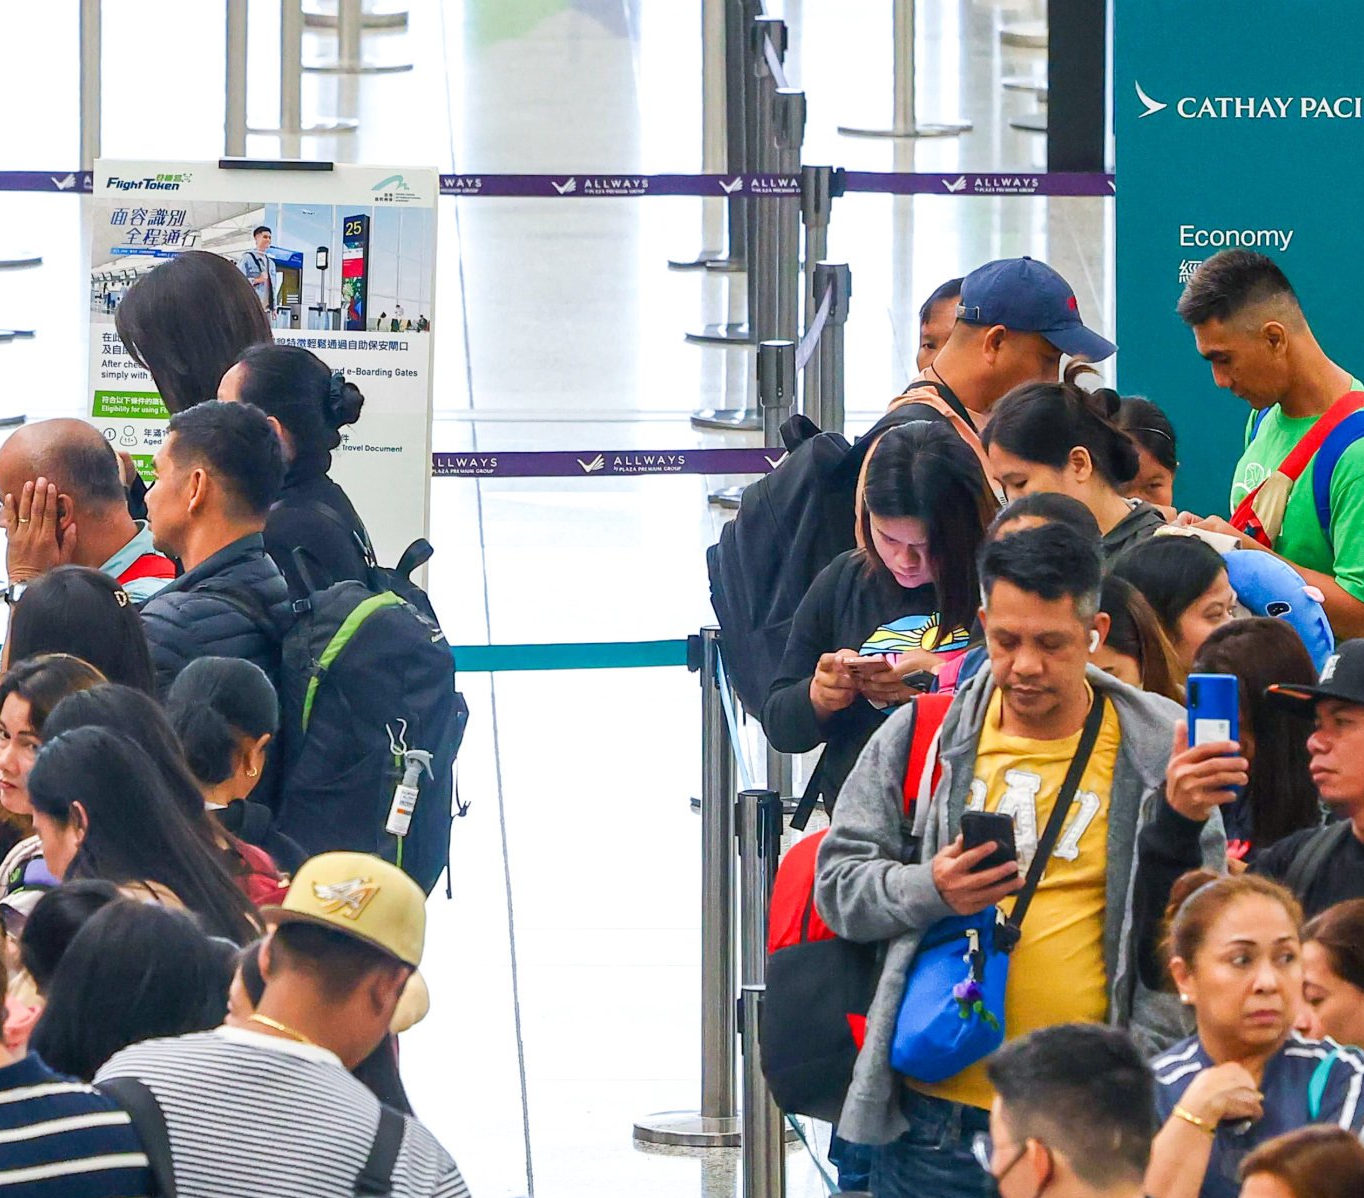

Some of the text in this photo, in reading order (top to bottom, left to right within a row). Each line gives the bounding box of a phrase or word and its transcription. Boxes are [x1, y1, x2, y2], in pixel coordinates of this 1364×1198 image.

[1177, 97, 1294, 119] CATHAY
[585, 178, 649, 188] ALLWAYS
[974, 178, 1039, 187] ALLWAYS
[345, 220, 362, 236] 25
[121, 227, 202, 248] 全程通行
[1179, 225, 1294, 251] Economy
[101, 360, 121, 368] After
[101, 371, 129, 381] simply
[346, 367, 393, 378] e-Boarding
[395, 368, 418, 377] Gates
[342, 444, 403, 453] Travel Document
[613, 455, 686, 466] ALLWAYS
